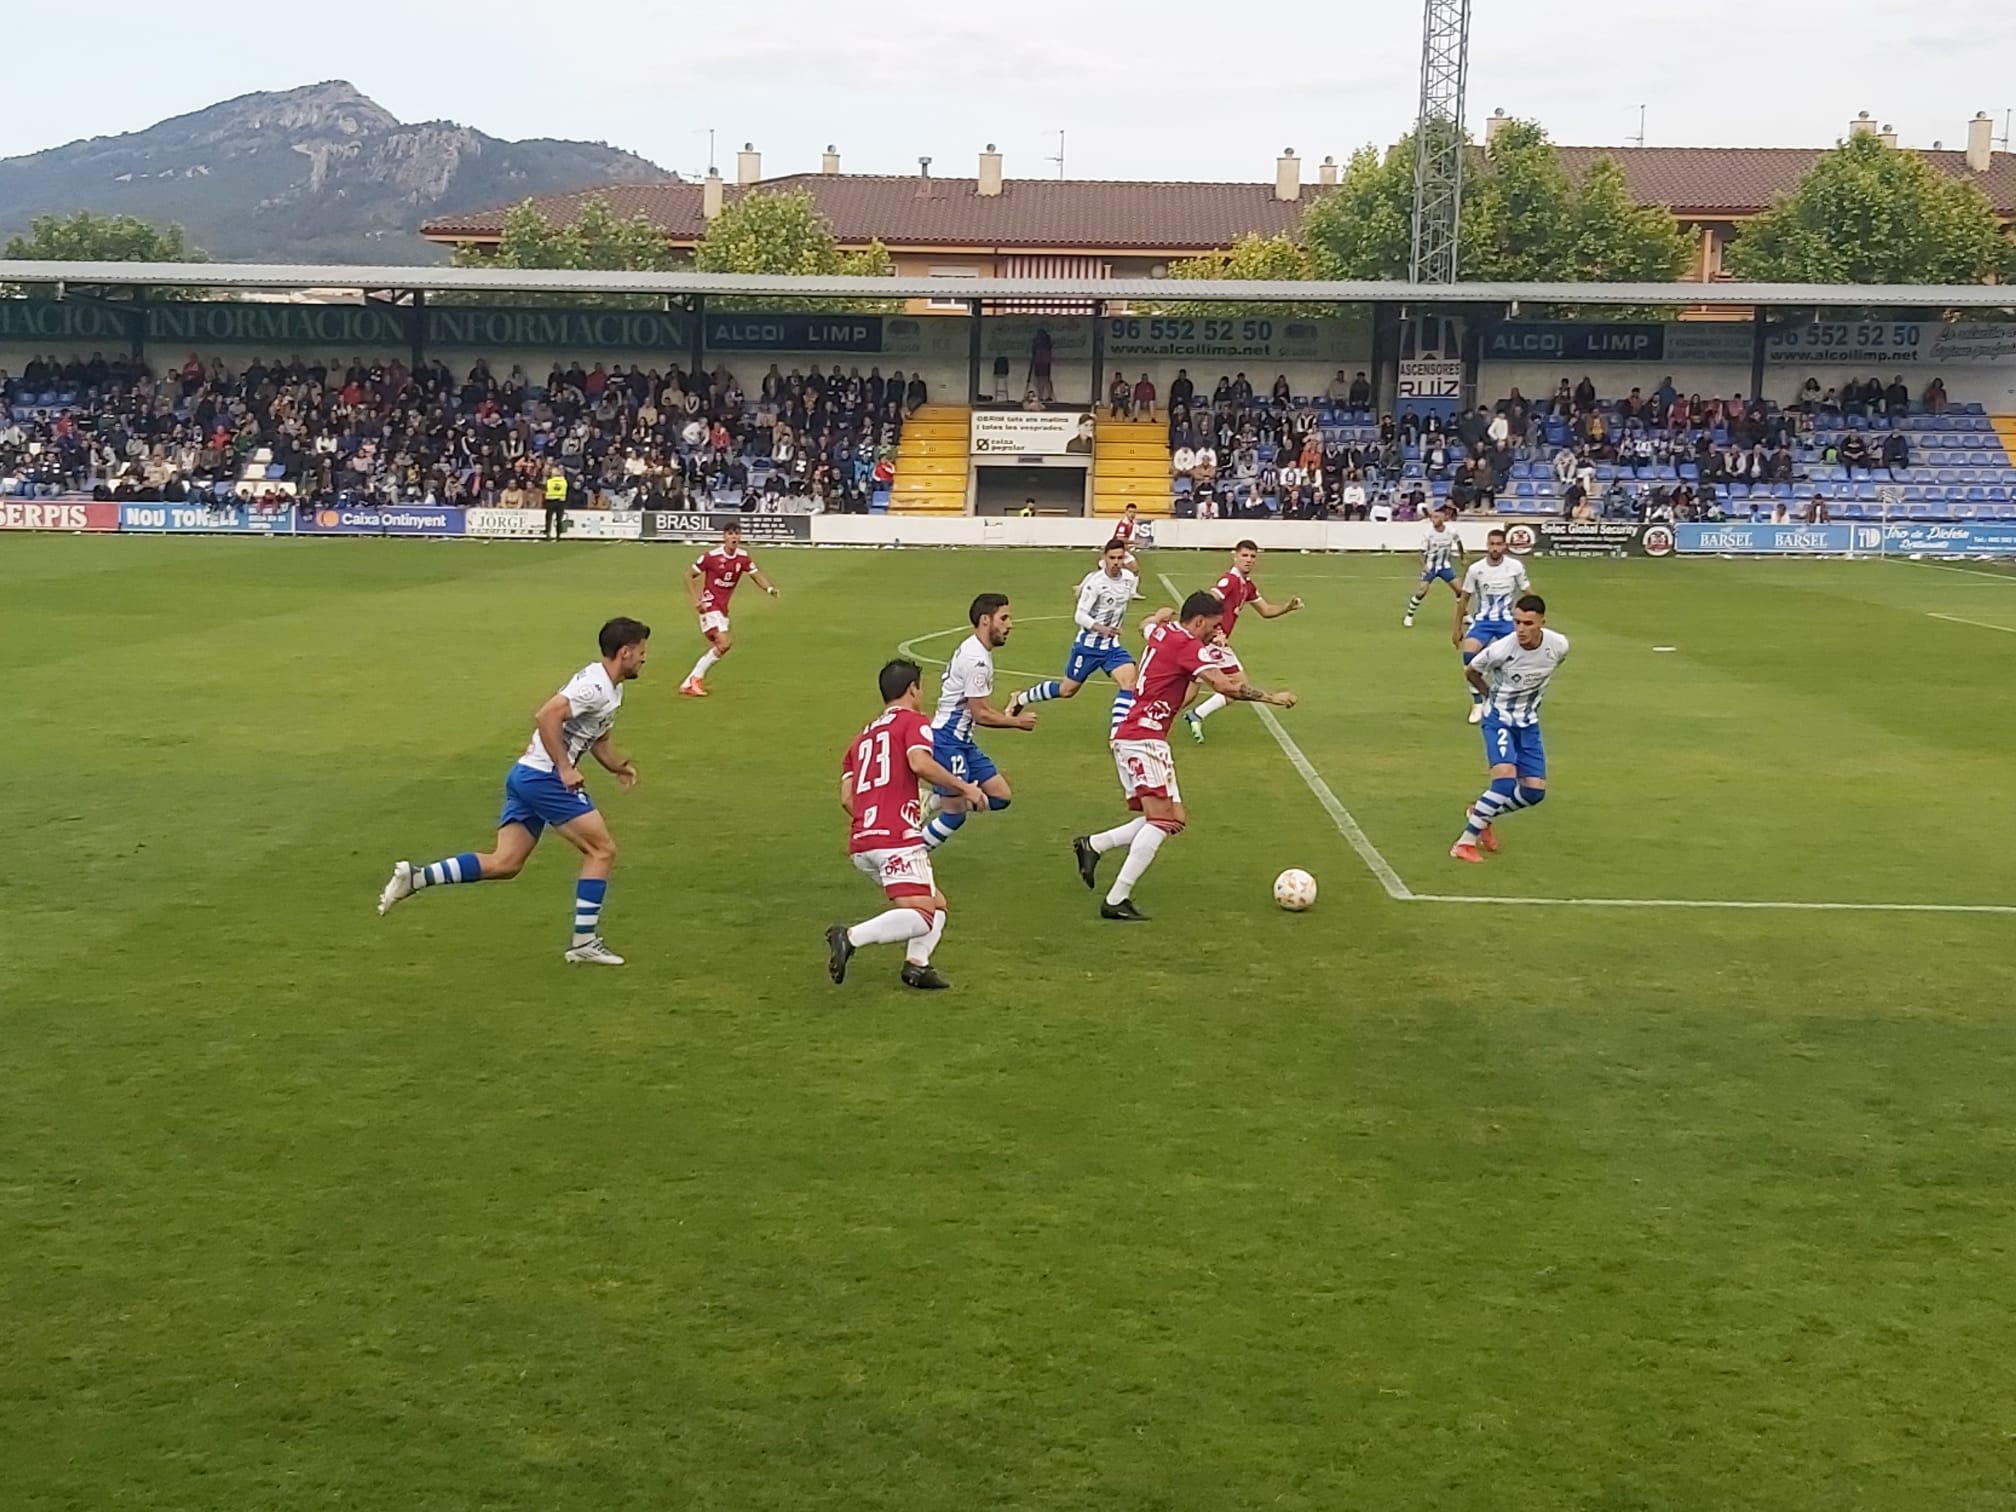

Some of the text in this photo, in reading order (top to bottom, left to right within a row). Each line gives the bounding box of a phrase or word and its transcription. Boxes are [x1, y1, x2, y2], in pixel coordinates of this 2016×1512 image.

[150, 308, 404, 340] INFORMACION
[429, 311, 683, 346] INFORMACION
[1111, 319, 1272, 341] 96 552 52 50
[715, 325, 867, 342] ALCOI LIMP
[1807, 325, 1849, 346] 552
[1856, 325, 1885, 346] 52
[1893, 325, 1920, 346] 50
[1110, 343, 1271, 356] www.alcoilimp.net
[1492, 334, 1563, 351] ALCOI
[1588, 334, 1649, 351] LIMP
[1770, 350, 1919, 362] www.alcoilimp.net
[1400, 363, 1461, 376] ASCENSORES
[126, 507, 166, 526] NOU
[342, 511, 446, 529] Caixa Ontinyent
[478, 515, 528, 529] JORGE
[656, 514, 715, 531] BRASIL
[1541, 523, 1638, 537] Selec Global Security
[1700, 533, 1752, 547] BARSEL
[1775, 533, 1828, 547] BARSEL
[1497, 728, 1509, 745] 2
[856, 730, 890, 795] 23
[951, 755, 966, 774] 12
